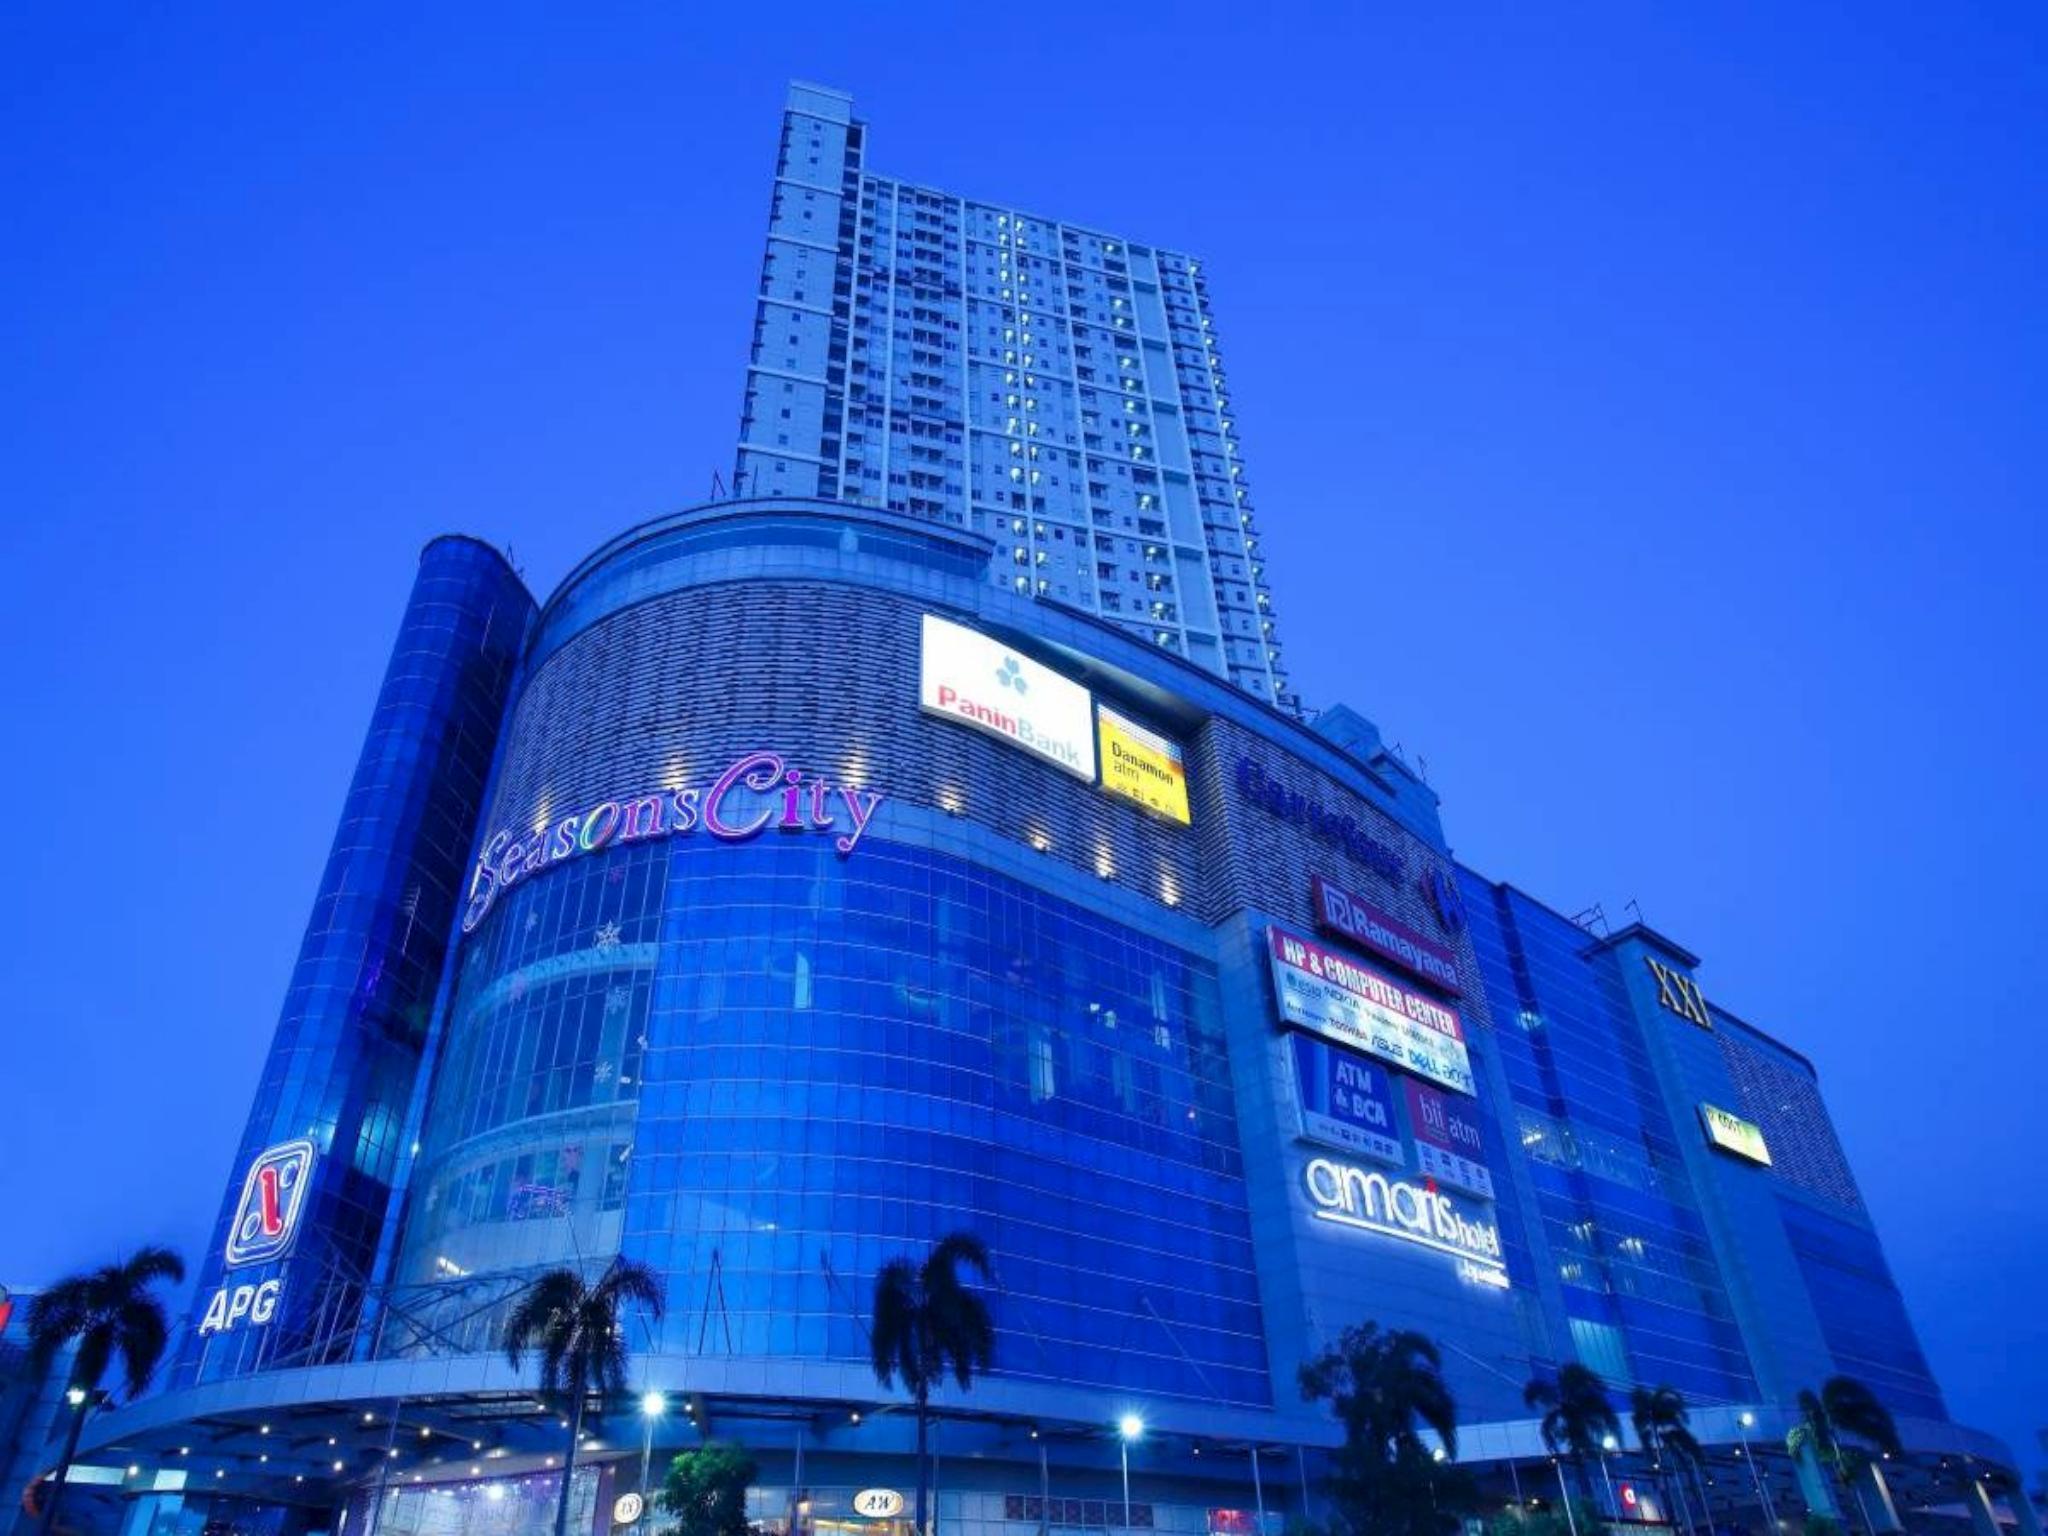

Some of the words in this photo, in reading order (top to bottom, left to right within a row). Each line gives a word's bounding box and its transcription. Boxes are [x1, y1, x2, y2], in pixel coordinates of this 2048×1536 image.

[1112, 740, 1174, 787] Danamon
[1324, 955, 1403, 1017] COMPUTER
[1404, 992, 1457, 1038] CENTER
[1644, 955, 1713, 1029] XXI
[1336, 1060, 1372, 1093] ATM
[1352, 1095, 1388, 1129] BCA
[199, 1279, 280, 1336] APG
